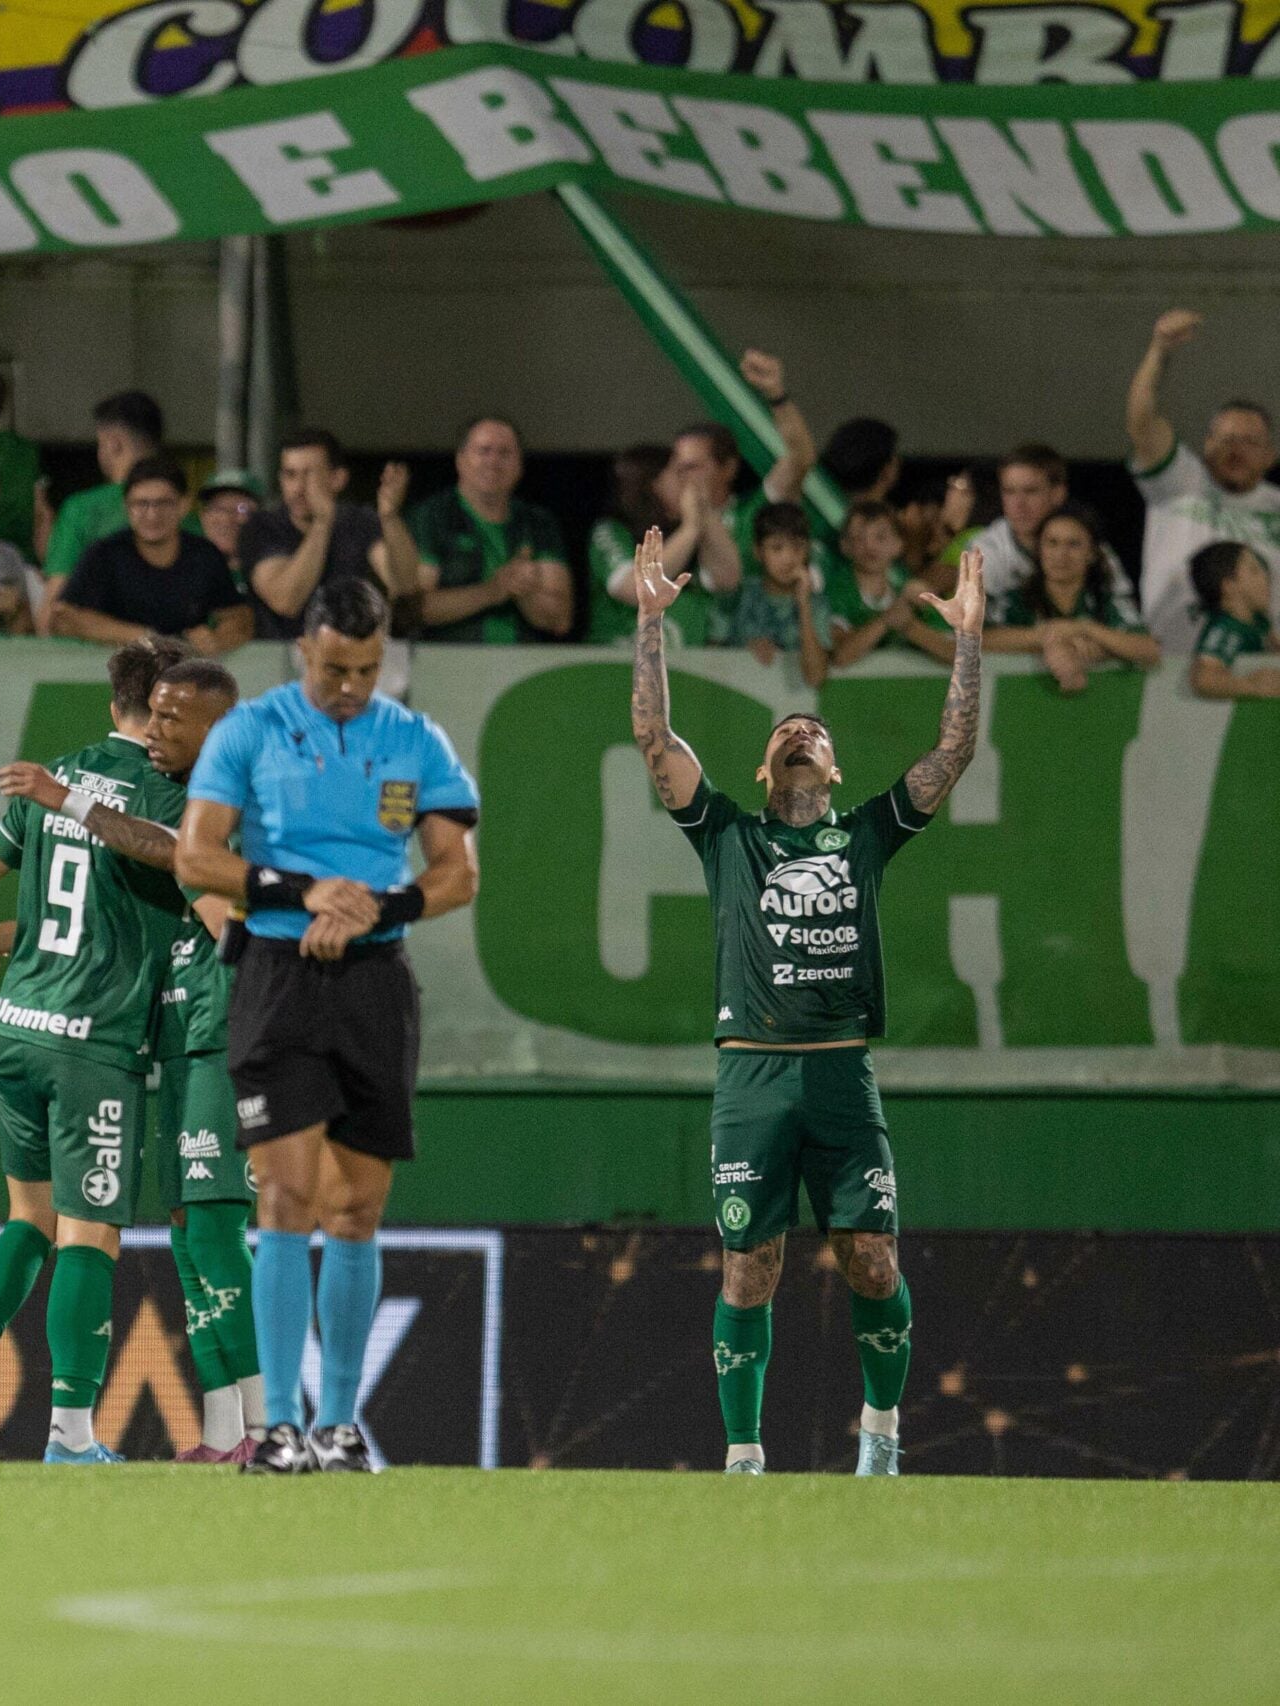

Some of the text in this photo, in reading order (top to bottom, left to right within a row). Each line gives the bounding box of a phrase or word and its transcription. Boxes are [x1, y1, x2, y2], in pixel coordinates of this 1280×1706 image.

[204, 110, 400, 225] E
[37, 843, 91, 957] 9
[760, 886, 858, 917] Aurora
[790, 926, 859, 945] SICOOB
[87, 1098, 122, 1170] alfa
[177, 1129, 219, 1156] Dalla
[719, 1161, 749, 1172] GRUPO
